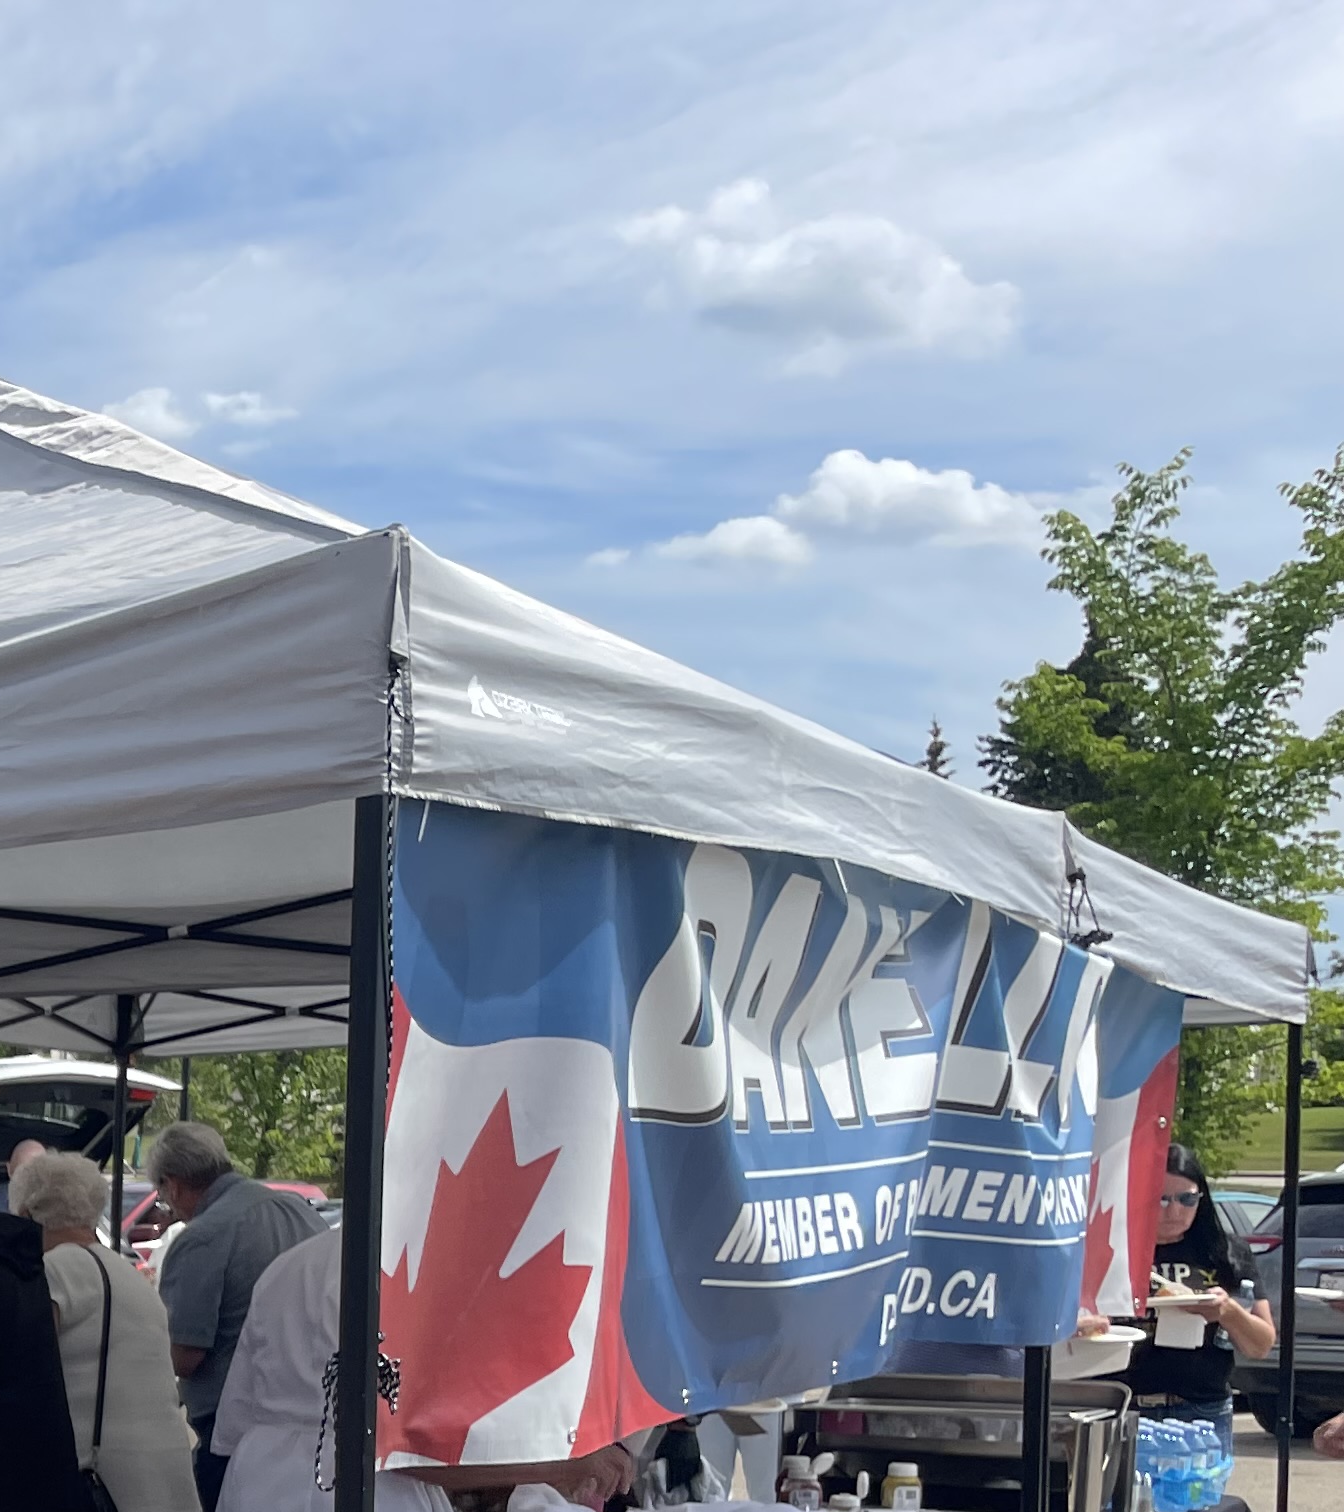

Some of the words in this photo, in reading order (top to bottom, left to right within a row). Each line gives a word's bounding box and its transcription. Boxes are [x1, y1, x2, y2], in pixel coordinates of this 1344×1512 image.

[628, 842, 939, 1134] DANE
[714, 1192, 864, 1265] MEMBER
[875, 1183, 906, 1246] OF
[917, 1164, 1037, 1226] MEN
